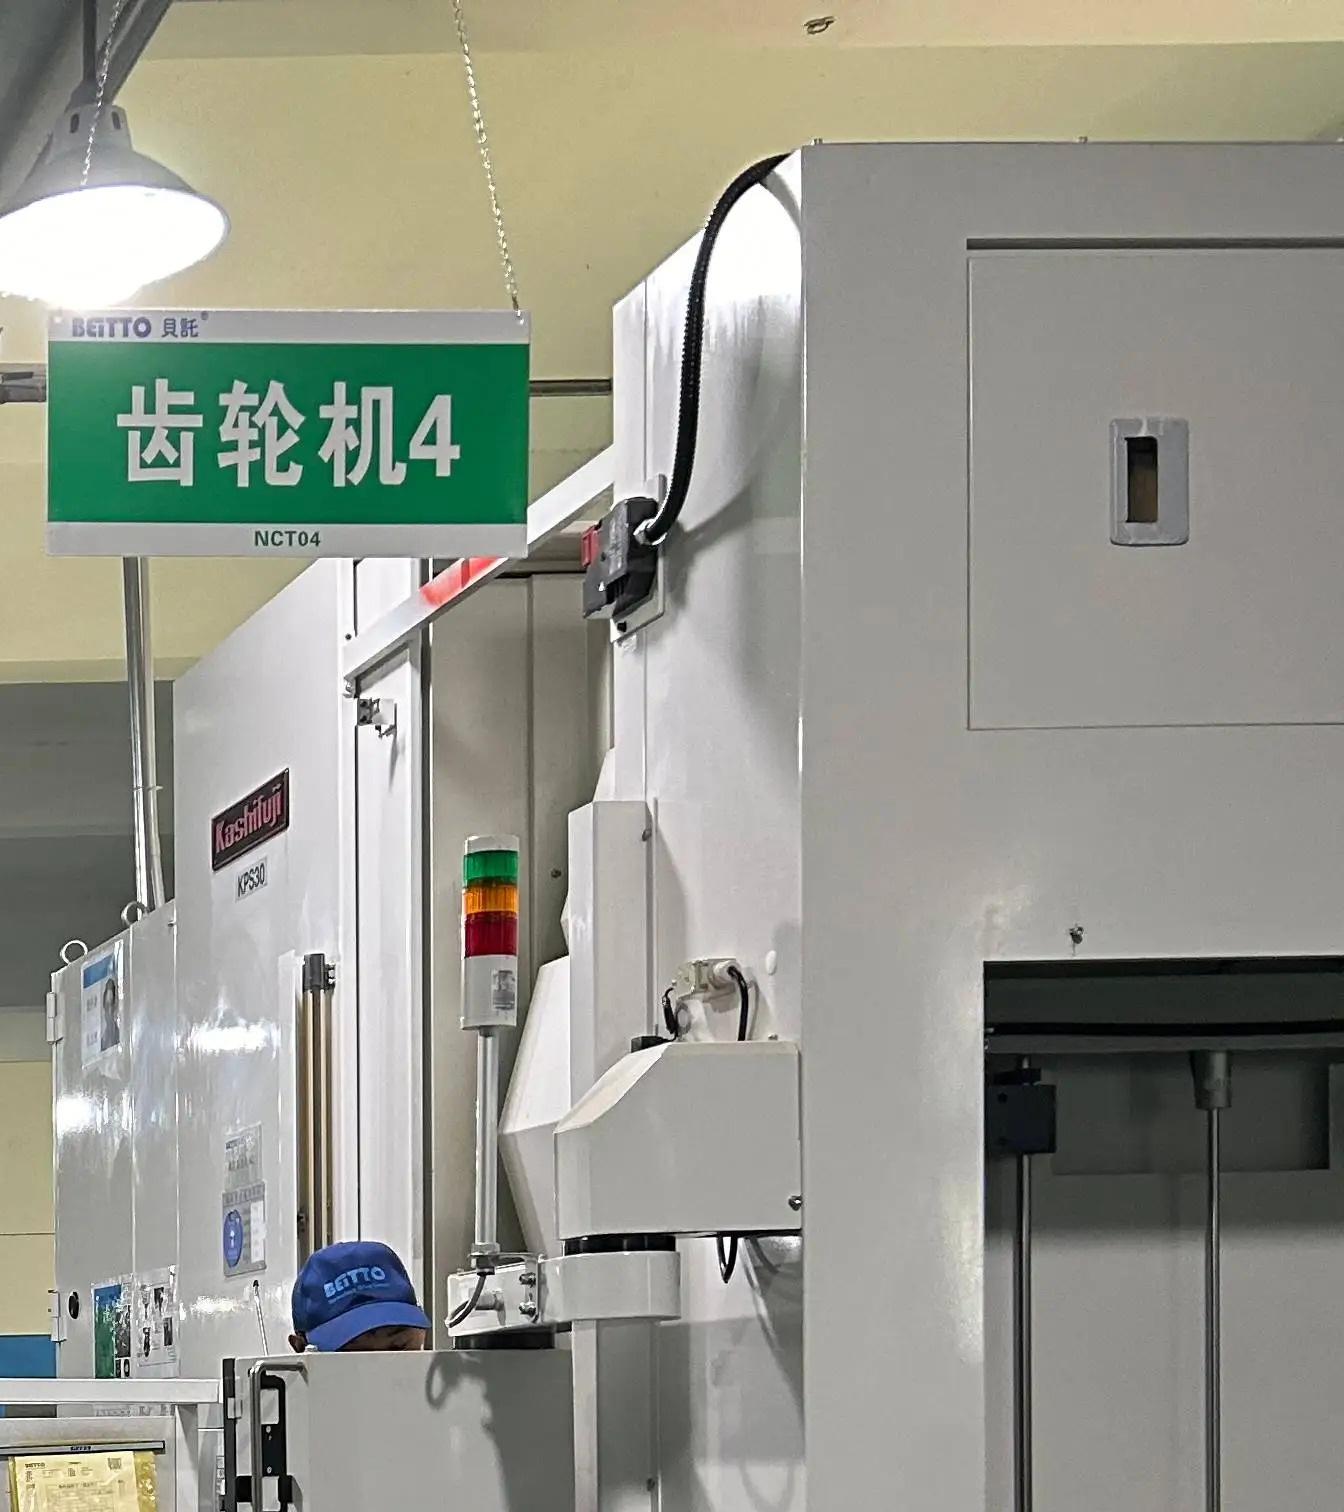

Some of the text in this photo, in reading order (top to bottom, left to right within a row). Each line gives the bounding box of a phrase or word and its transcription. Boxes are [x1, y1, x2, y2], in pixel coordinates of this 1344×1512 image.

[117, 378, 461, 488] 齿轮机4
[254, 531, 321, 548] NCT04
[215, 783, 282, 853] Kashifuji
[323, 1266, 386, 1298] BEITTO
